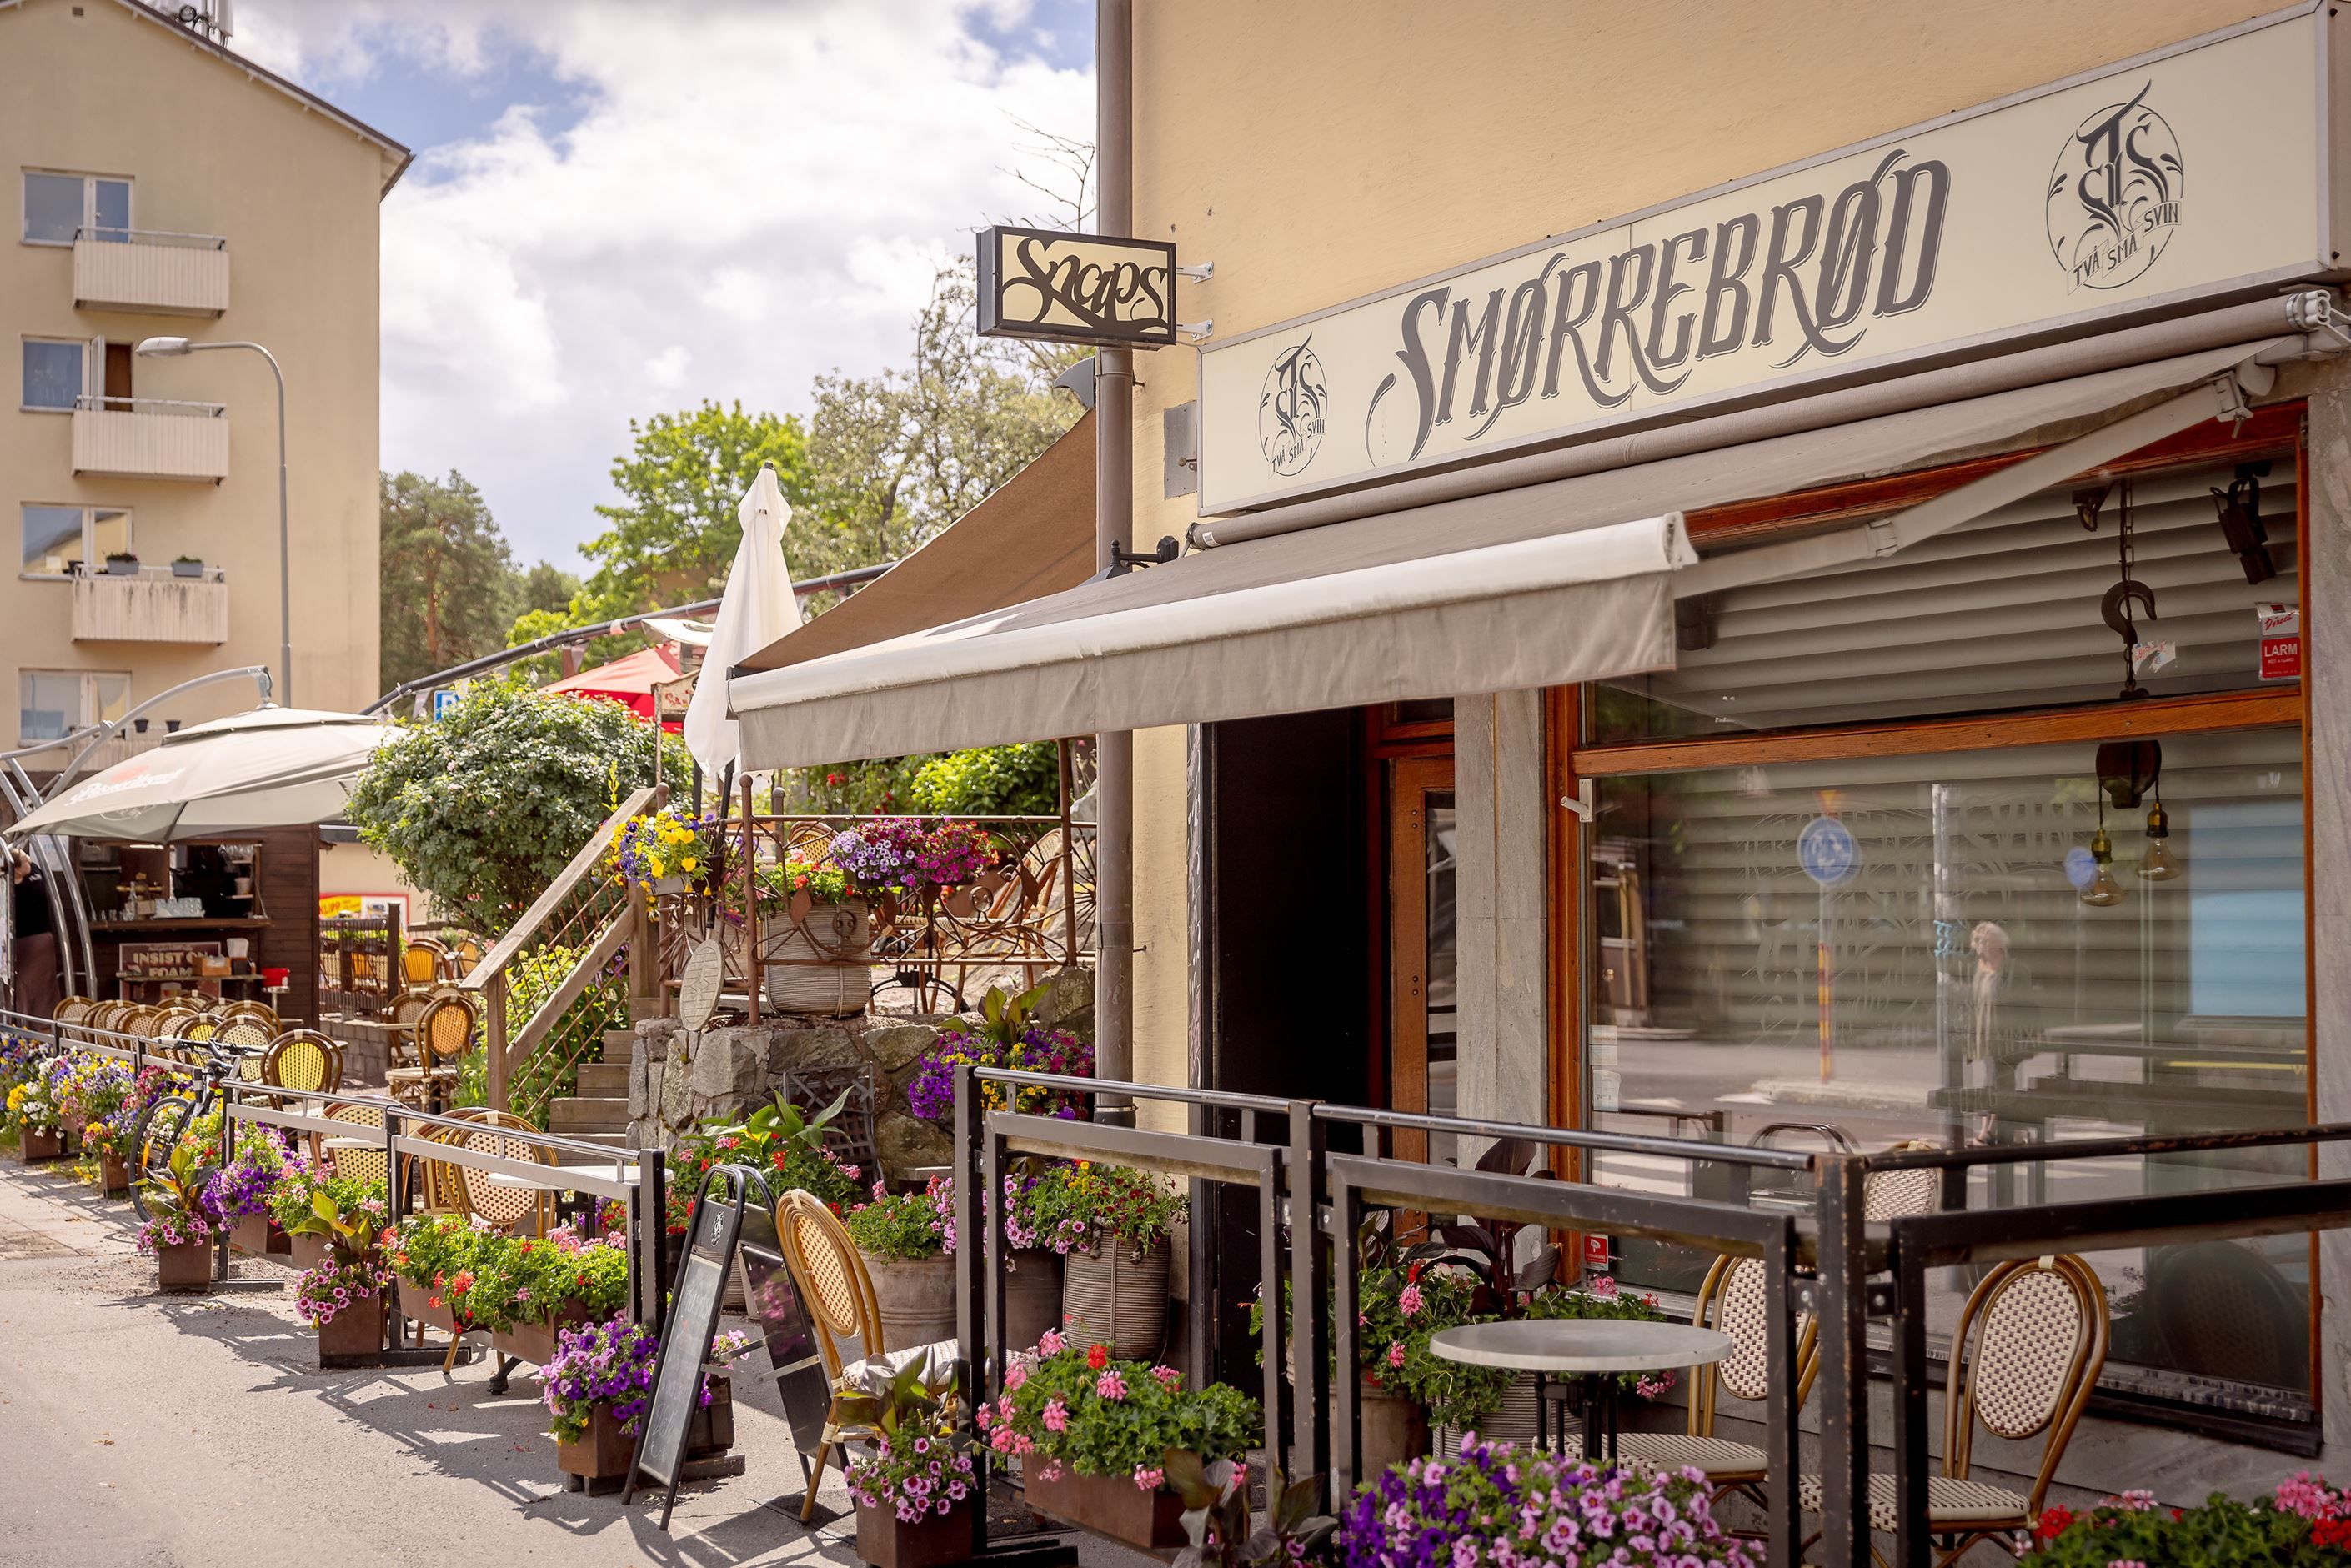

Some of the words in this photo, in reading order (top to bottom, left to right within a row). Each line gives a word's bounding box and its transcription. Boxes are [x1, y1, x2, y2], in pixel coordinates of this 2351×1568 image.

[2073, 246, 2100, 286] TVÅ
[2108, 228, 2138, 271] SMÅ
[2144, 203, 2178, 233] SVIN
[1003, 237, 1169, 332] Snaps
[1366, 148, 1952, 469] SMØRREBRØD
[1271, 444, 1286, 473] TVÅ
[1289, 437, 1304, 463] SMÅ
[1307, 418, 1325, 438] SVIN
[2264, 643, 2298, 658] LARM
[133, 951, 184, 966] INSIST
